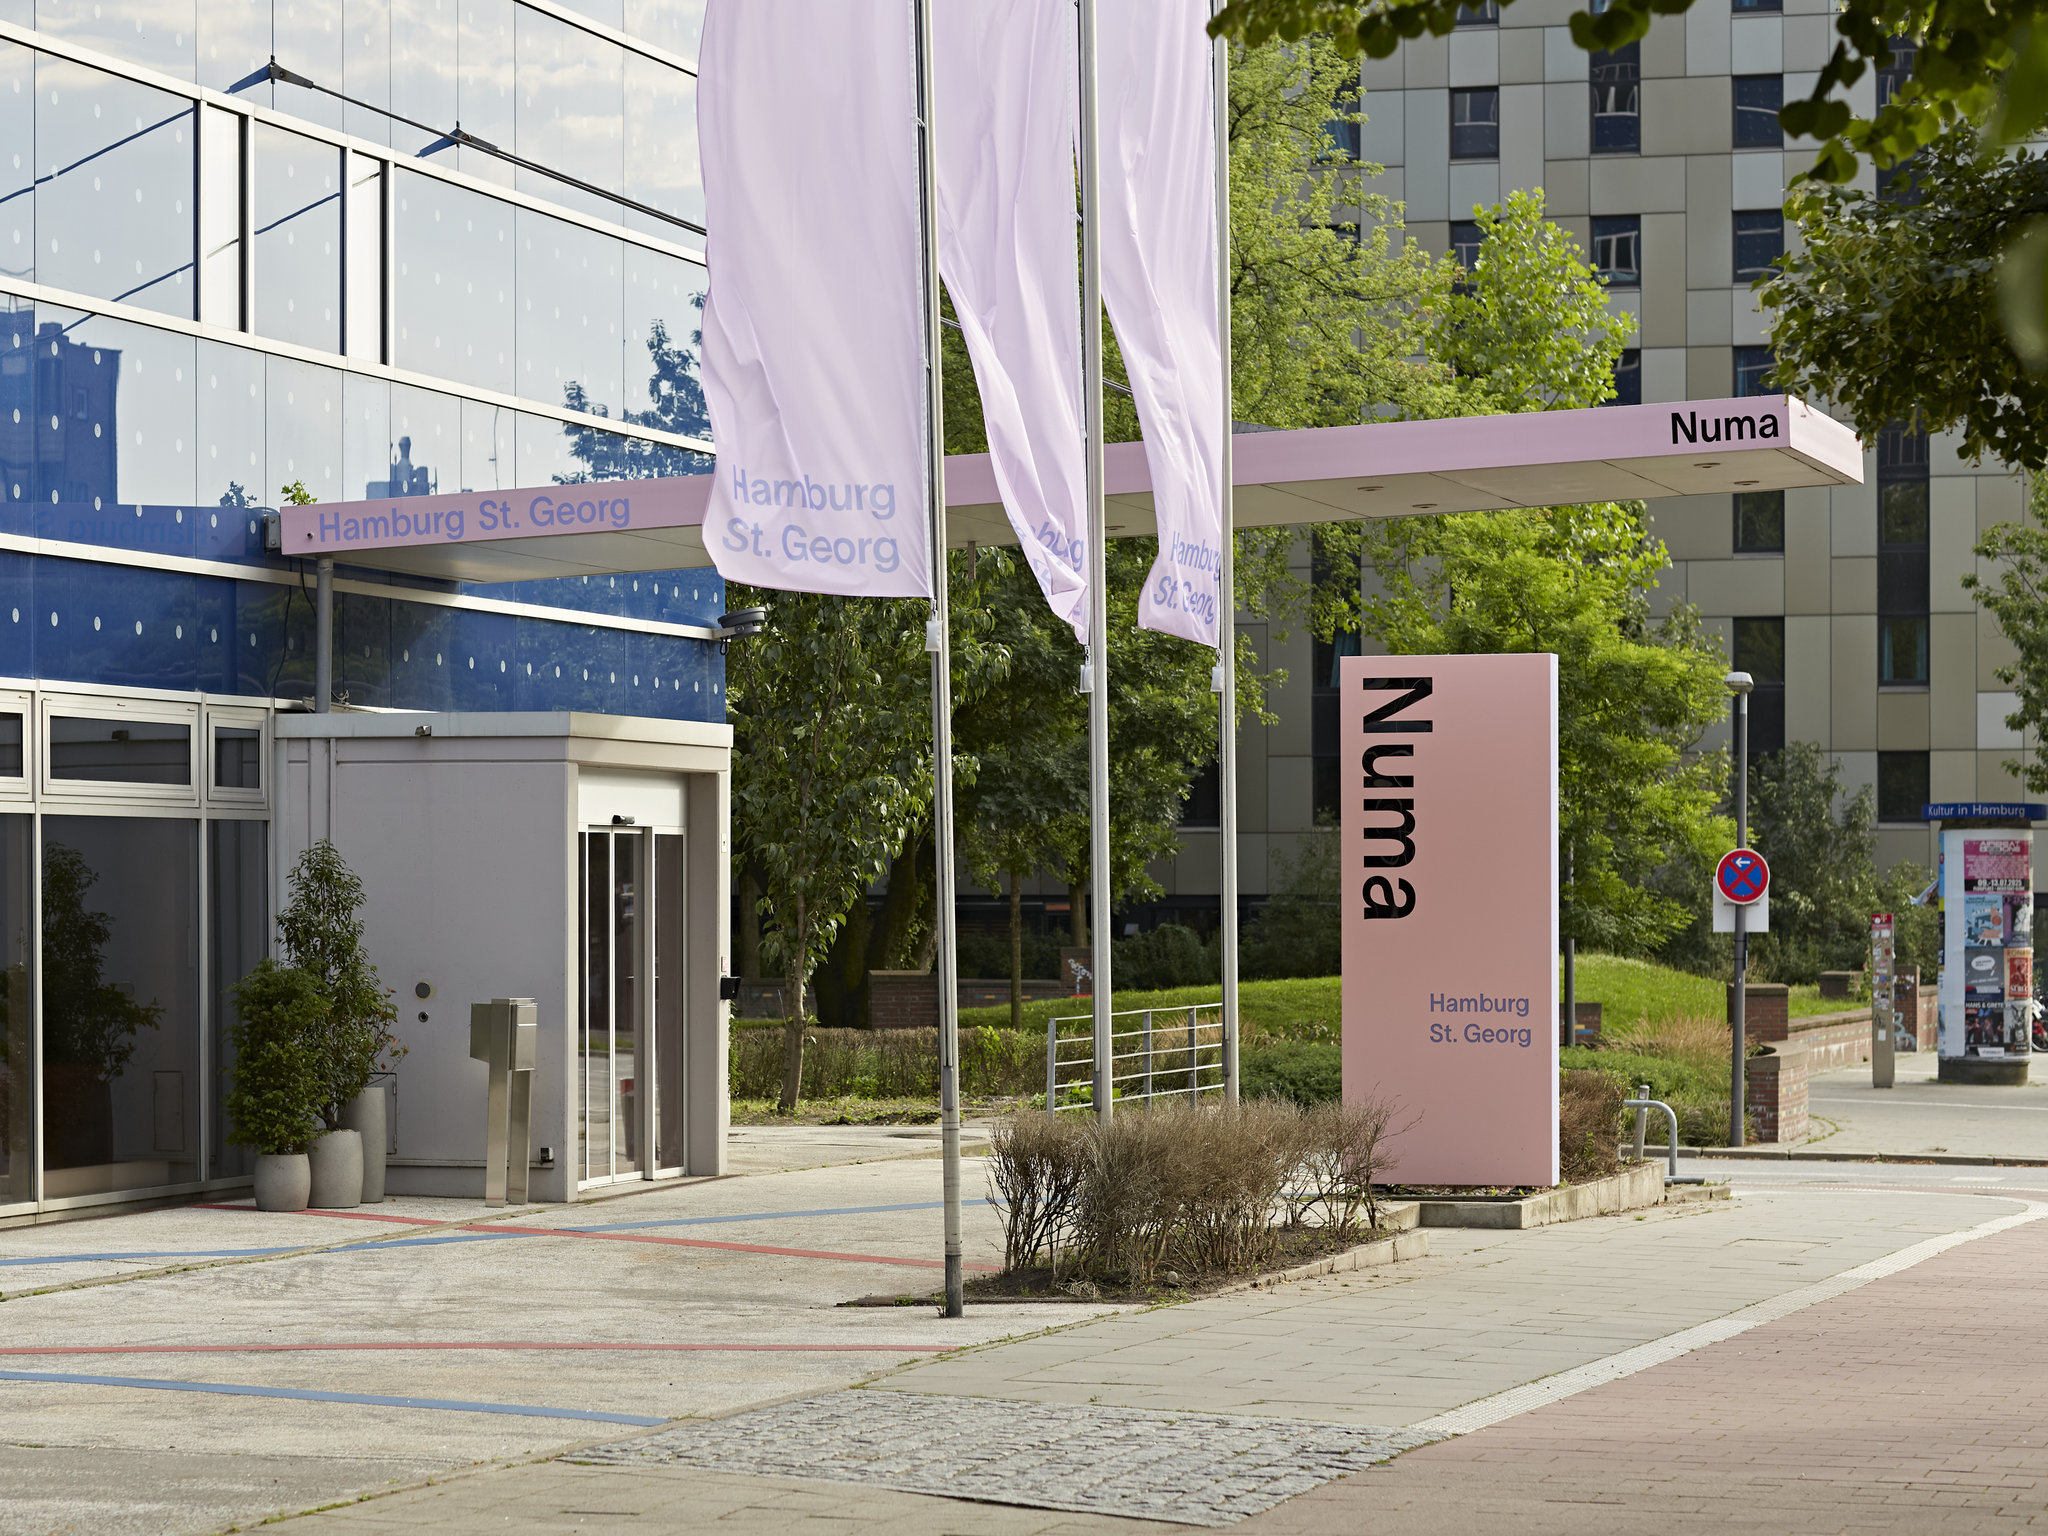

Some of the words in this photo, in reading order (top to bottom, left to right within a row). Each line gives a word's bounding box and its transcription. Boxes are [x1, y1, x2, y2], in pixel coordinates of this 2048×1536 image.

[1671, 411, 1779, 444] Numa
[733, 464, 896, 520] Hamburg
[319, 508, 465, 543] Hamburg
[479, 500, 520, 531] St.
[529, 496, 631, 528] Georg
[722, 517, 772, 558] St.
[782, 524, 900, 574] Georg
[1153, 575, 1179, 610] St.
[1362, 676, 1434, 920] Numa
[1928, 805, 1954, 817] Kultur
[1958, 804, 1968, 816] in
[1972, 804, 2026, 818] Hamburg
[1429, 993, 1530, 1017] Hamburg
[1429, 1023, 1457, 1043] St.
[1464, 1023, 1532, 1047] Georg
